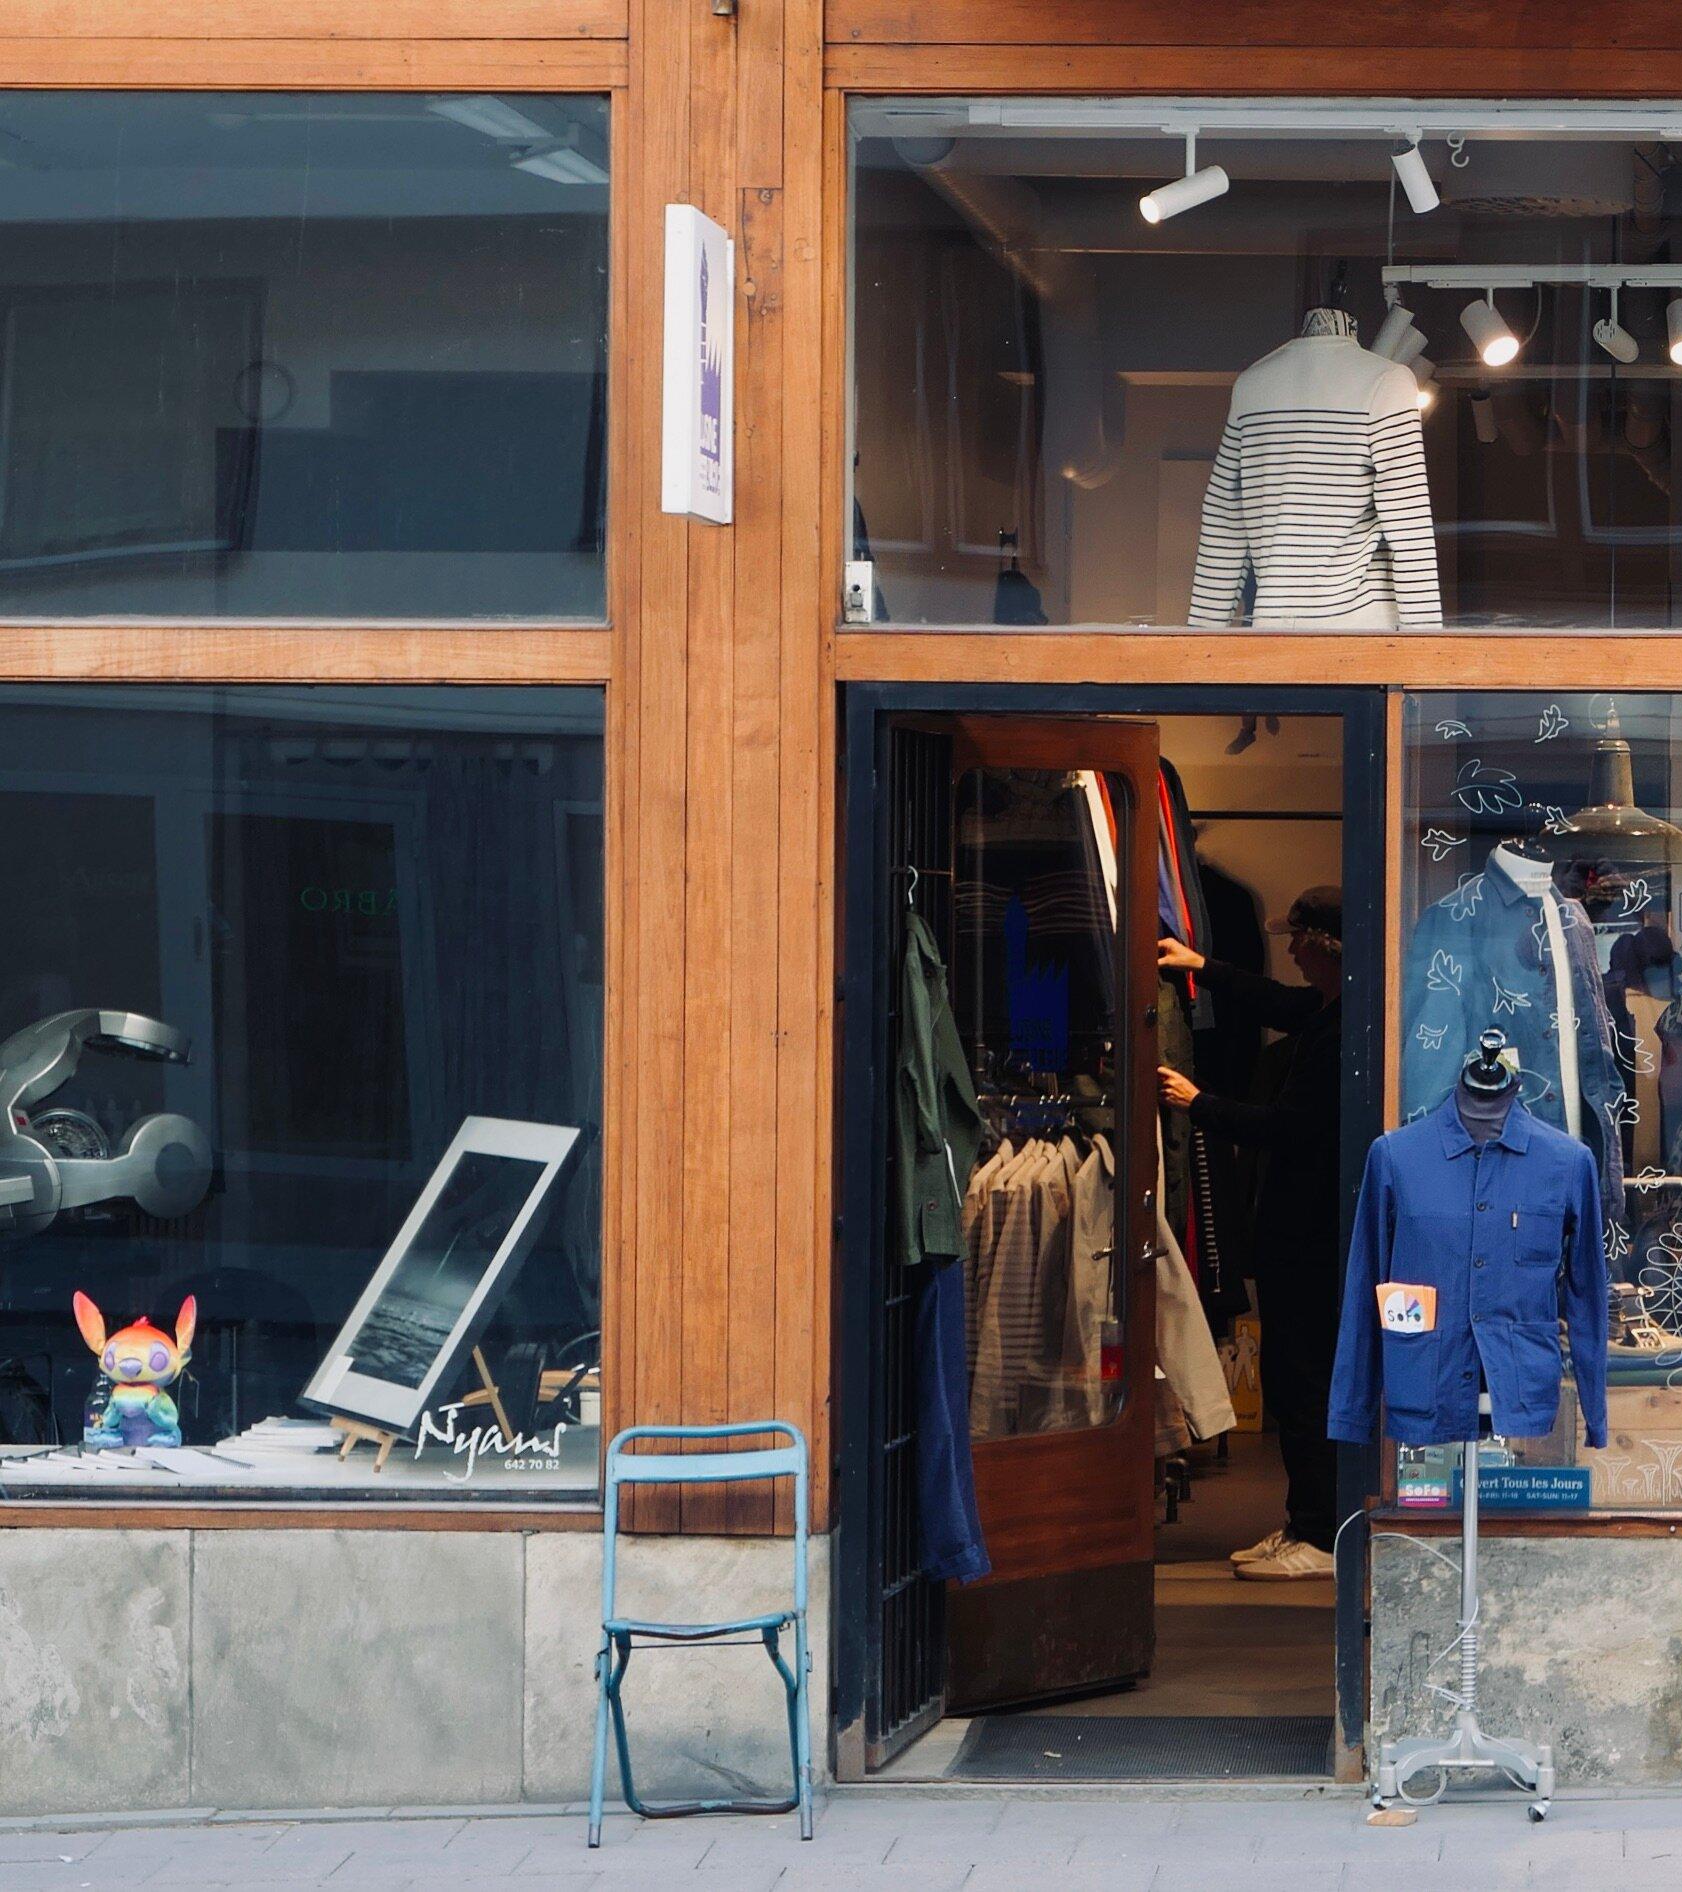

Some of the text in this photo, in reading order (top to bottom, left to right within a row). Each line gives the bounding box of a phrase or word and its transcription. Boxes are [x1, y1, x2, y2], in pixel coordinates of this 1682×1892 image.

[414, 1402, 567, 1483] Nyans
[504, 1459, 560, 1470] 642 70 82
[1501, 1476, 1529, 1490] Tous
[1531, 1476, 1548, 1490] les
[1550, 1476, 1584, 1491] Jours
